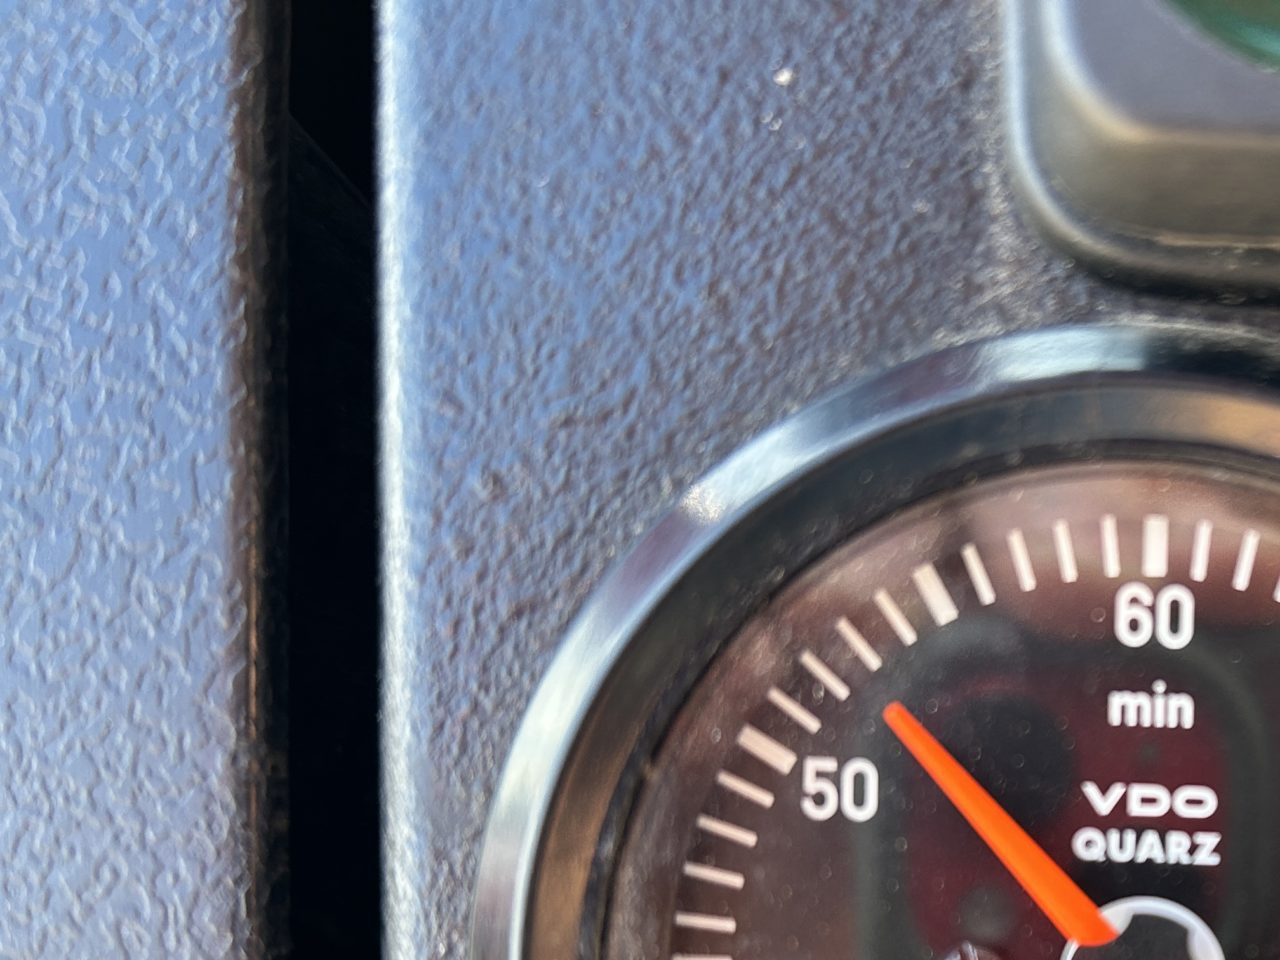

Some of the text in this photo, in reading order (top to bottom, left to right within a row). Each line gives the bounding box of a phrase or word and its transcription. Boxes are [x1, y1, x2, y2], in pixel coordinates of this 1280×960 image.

[1114, 581, 1195, 649] 60
[1107, 680, 1195, 728] min
[800, 757, 879, 822] 50
[1081, 781, 1219, 818] VDO
[1072, 827, 1221, 866] QUARZ
